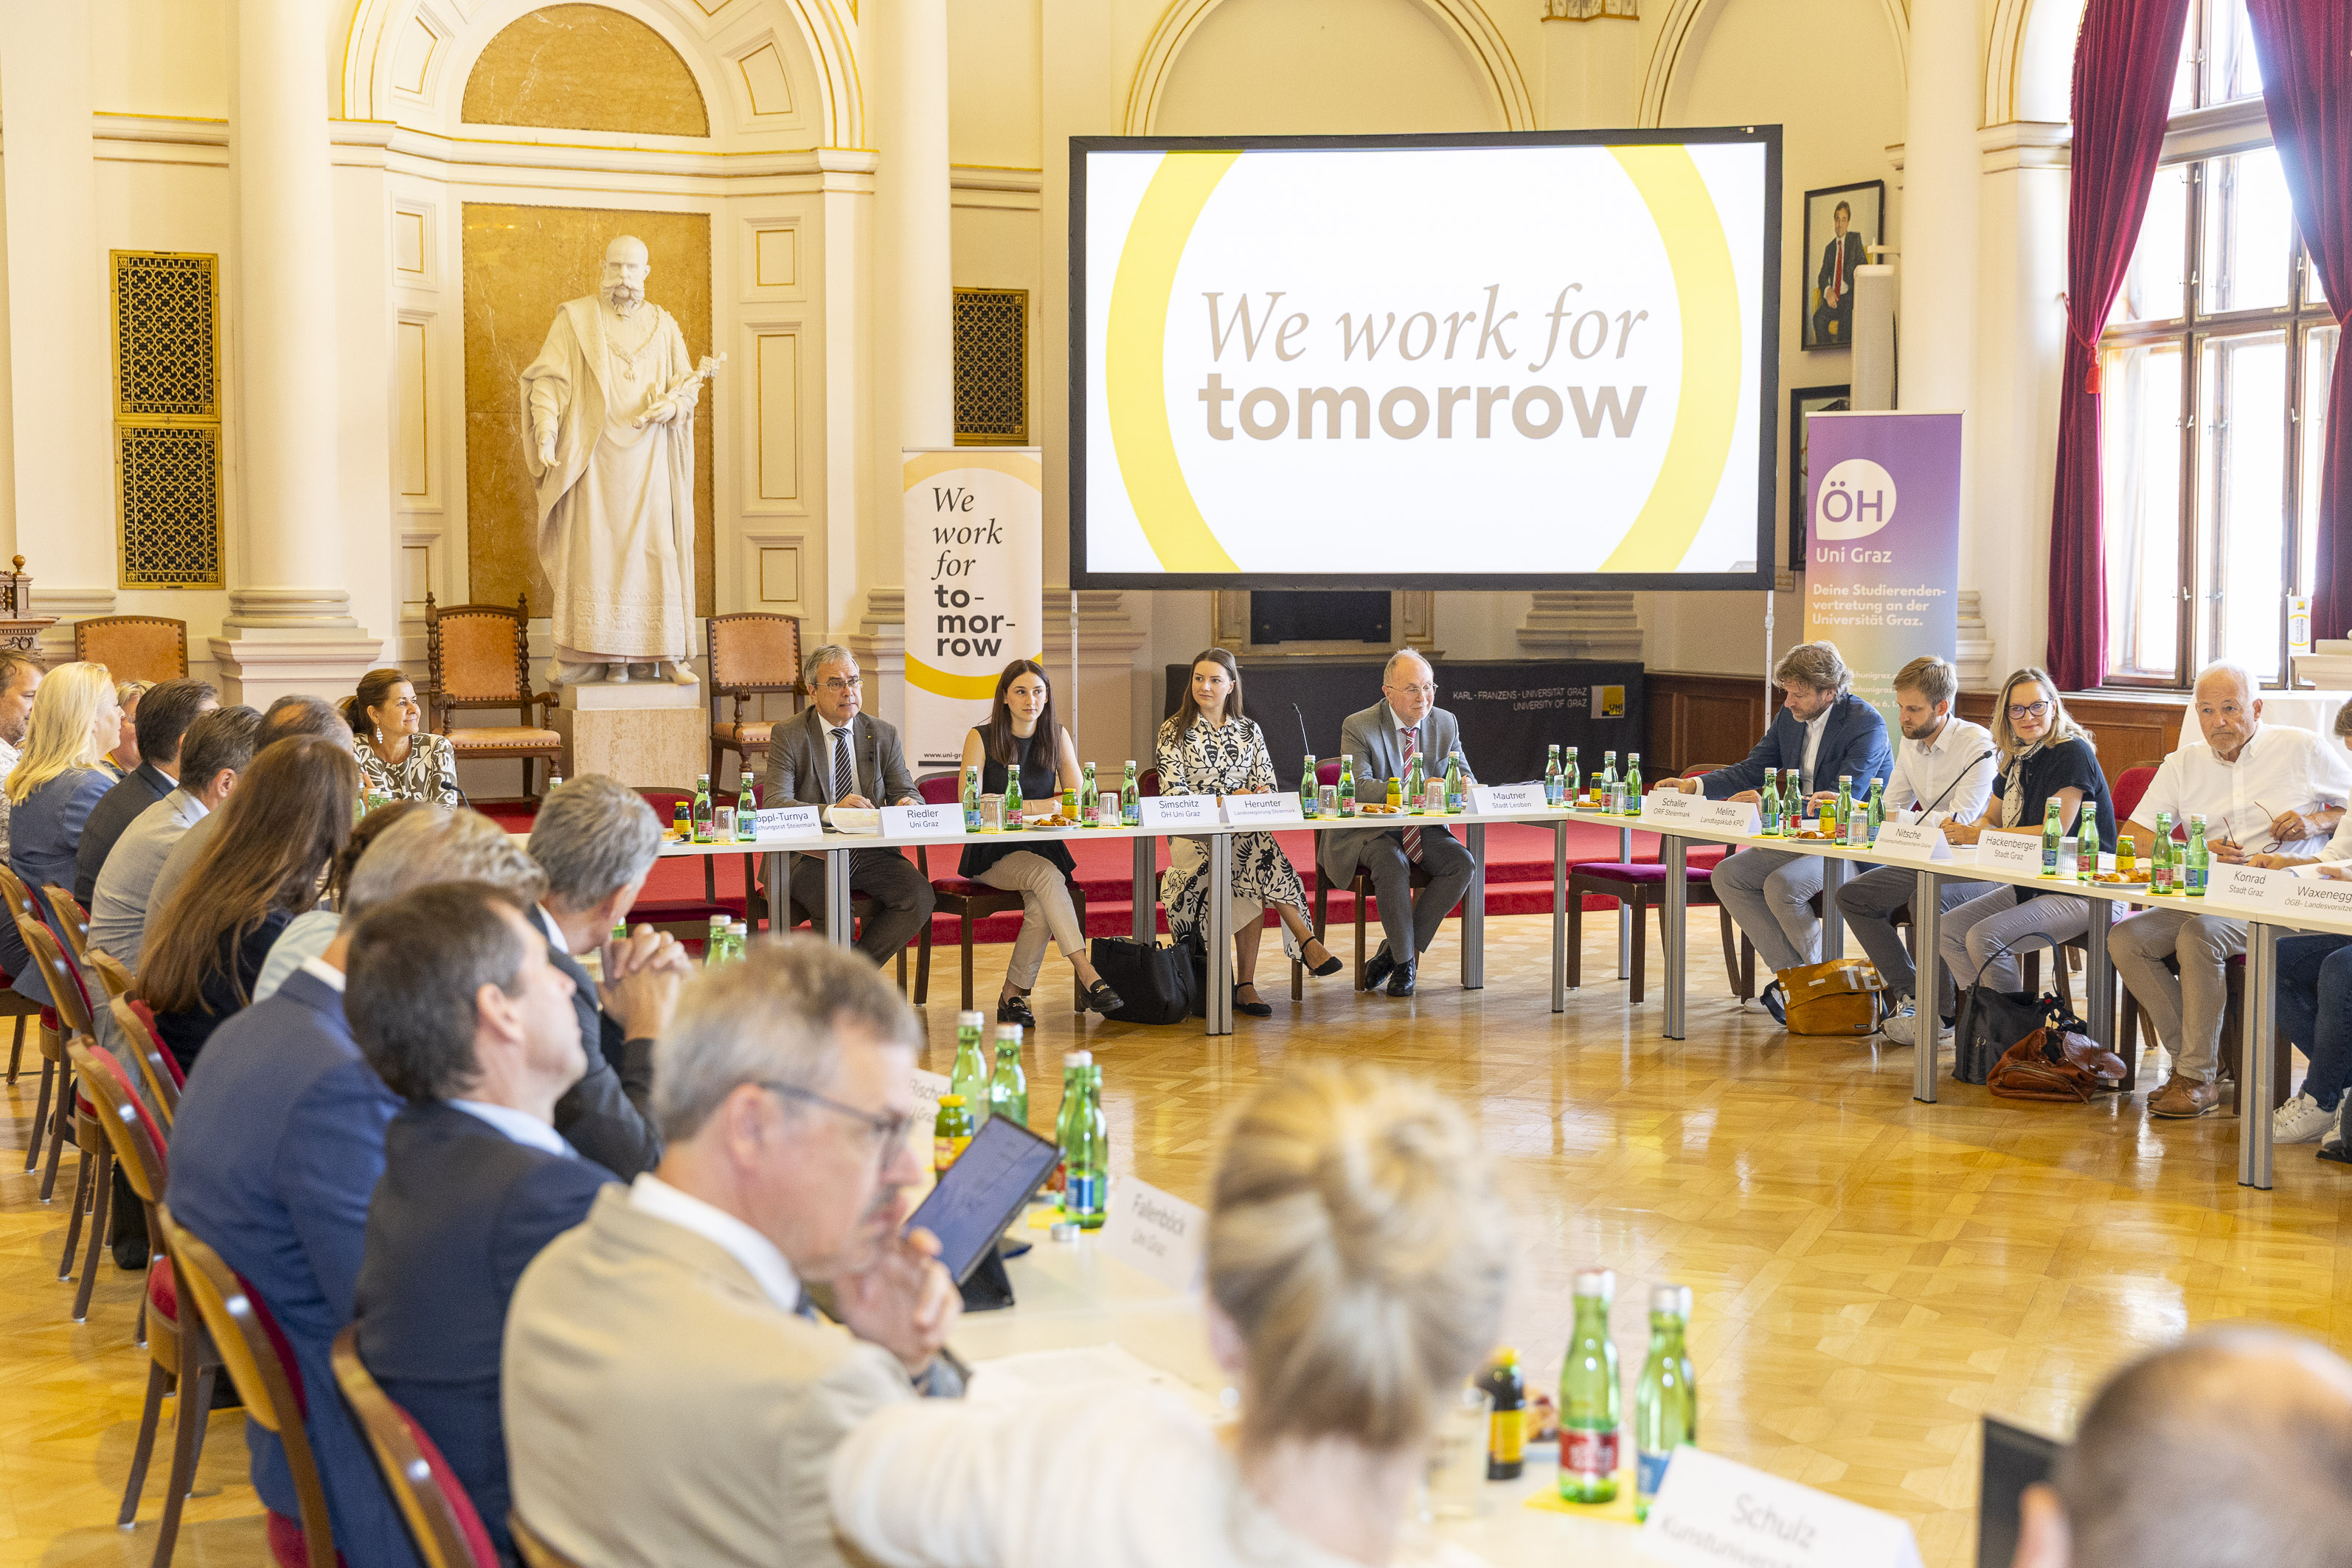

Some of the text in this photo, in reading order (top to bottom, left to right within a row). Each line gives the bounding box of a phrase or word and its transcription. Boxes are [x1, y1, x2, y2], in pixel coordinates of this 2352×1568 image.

[1201, 282, 1649, 373] We work for
[1198, 372, 1648, 441] tomorrow
[932, 487, 974, 513] We
[1822, 480, 1883, 523] ÖH
[932, 518, 1003, 545] work
[1816, 547, 1893, 563] Uni Graz
[931, 549, 976, 580] for
[934, 584, 985, 608] to-
[1813, 583, 1946, 597] Deine Studierenden-
[1812, 600, 1930, 614] vertretung an der
[937, 614, 1016, 634] mor-
[1812, 613, 1923, 627] Universität Graz.
[936, 638, 1003, 657] row
[1567, 687, 1587, 696] GRAZ
[1513, 698, 1587, 711] UNIVERSITY OF GRAZ
[923, 752, 962, 760] www.uni-gr
[1493, 791, 1526, 800] Mautner
[1662, 797, 1687, 808] Schaller
[1159, 799, 1200, 809] Simschitz
[1244, 799, 1281, 808] Herunter
[1492, 800, 1532, 809] Stadt Leoben
[756, 812, 808, 824] öppl-Turnya
[907, 809, 939, 819] Riedler
[1665, 809, 1690, 818] Steiermark
[1716, 807, 1736, 816] Melinz
[922, 820, 939, 828] Graz
[1700, 816, 1732, 825] Landtagsklub
[1895, 828, 1921, 839] Nitsche
[1985, 835, 2037, 852] Hackenberger
[1994, 849, 2024, 861] Stadt Graz
[2233, 870, 2266, 884] Konrad
[2228, 884, 2263, 898] Stadt Graz
[2297, 885, 2352, 903] Waxenegg
[2304, 901, 2352, 912] Landesvorsitze
[1731, 1491, 1818, 1551] Schulz
